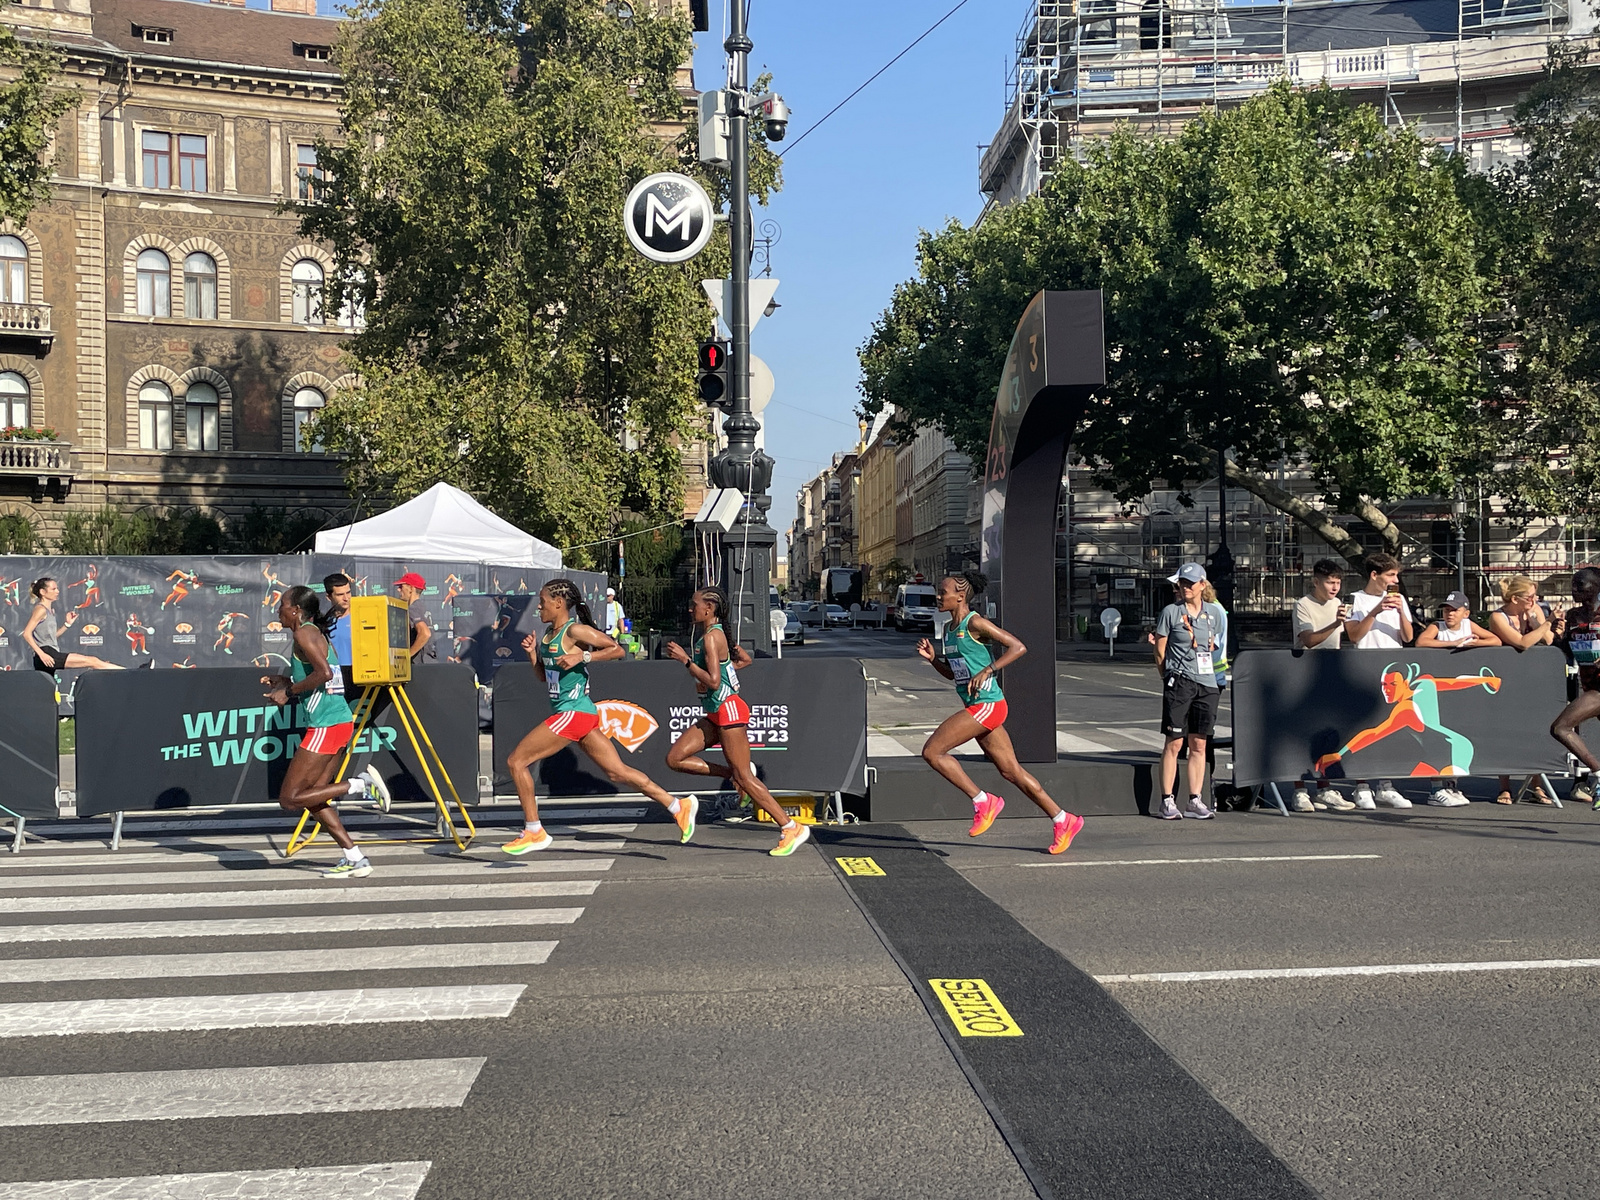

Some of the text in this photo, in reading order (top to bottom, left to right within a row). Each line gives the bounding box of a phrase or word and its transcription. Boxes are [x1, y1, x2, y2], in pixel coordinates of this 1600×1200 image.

[644, 192, 691, 241] M
[1029, 333, 1039, 373] 3
[991, 445, 1007, 482] 23
[182, 698, 372, 740] WITNES
[669, 706, 708, 717] WORL
[160, 742, 203, 761] THE
[767, 729, 789, 742] 23
[939, 980, 1010, 1033] SEIKO
